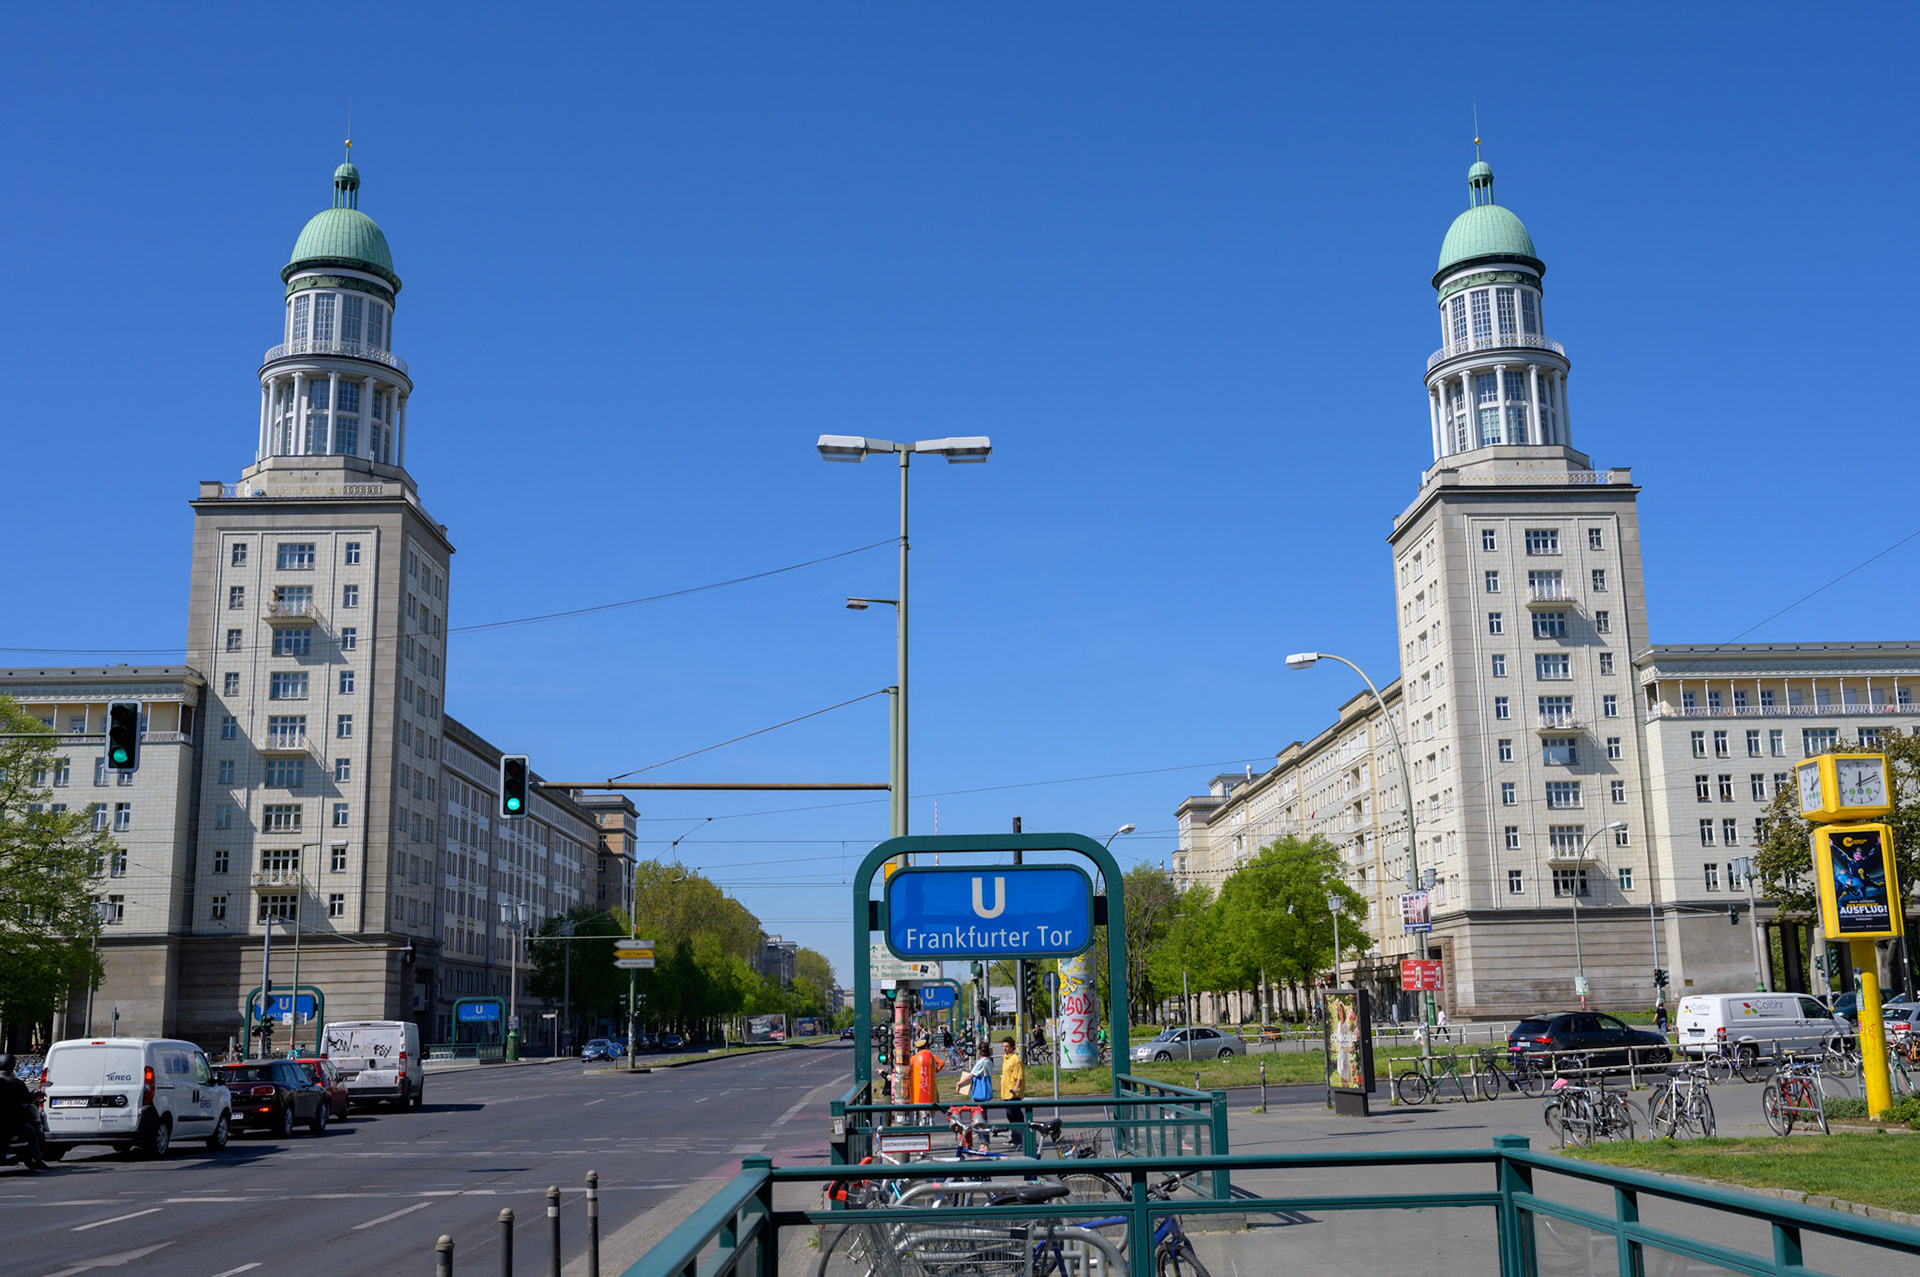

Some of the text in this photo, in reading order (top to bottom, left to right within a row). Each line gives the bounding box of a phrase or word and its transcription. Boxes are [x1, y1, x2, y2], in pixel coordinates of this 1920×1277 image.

[972, 876, 1006, 918] U
[1840, 904, 1888, 915] AUSFLUG!
[906, 926, 1073, 950] Frankfurter Tor
[925, 988, 934, 999] U
[279, 997, 289, 1010] U
[475, 1005, 483, 1014] U
[106, 1072, 132, 1081] TEREG
